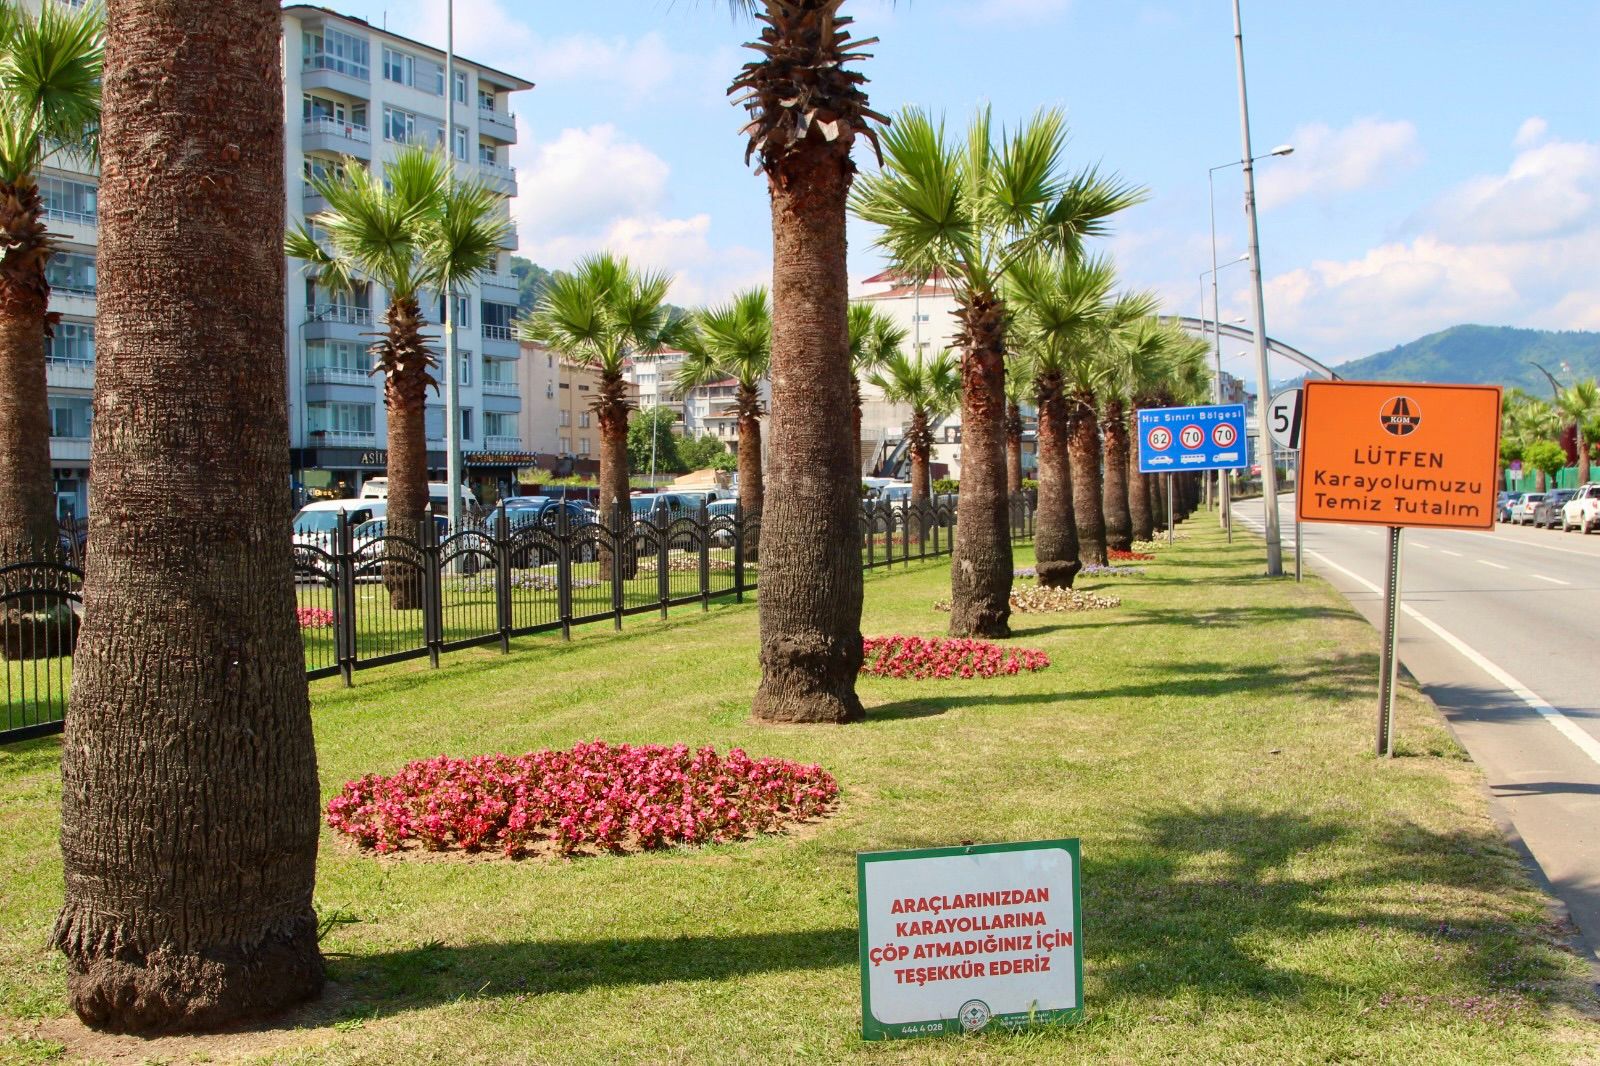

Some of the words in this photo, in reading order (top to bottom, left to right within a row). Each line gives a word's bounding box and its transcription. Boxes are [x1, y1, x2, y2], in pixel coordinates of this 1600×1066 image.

[1165, 413, 1195, 421] Sınırı
[1199, 410, 1241, 420] Bölgesi
[1274, 405, 1289, 433] 5
[1153, 433, 1167, 444] 82
[1185, 431, 1199, 442] 70
[1217, 430, 1231, 441] 70
[361, 451, 388, 464] ASİL
[1354, 445, 1444, 469] LÜTFEN
[1314, 470, 1481, 494] Karayolumuzu
[1315, 493, 1381, 511] Temiz
[1394, 497, 1479, 517] Tutalım
[891, 887, 1049, 915] ARAÇLARINIZDAN
[896, 911, 1046, 937] KARAYOLLARINA
[869, 943, 909, 966] ÇÖP
[913, 934, 1032, 960] ATMADIĞINIZ
[1036, 928, 1073, 952] İÇİN
[894, 960, 985, 986] TEŞEKKÜR
[989, 953, 1050, 976] EDERİZ
[928, 1023, 943, 1031] 028
